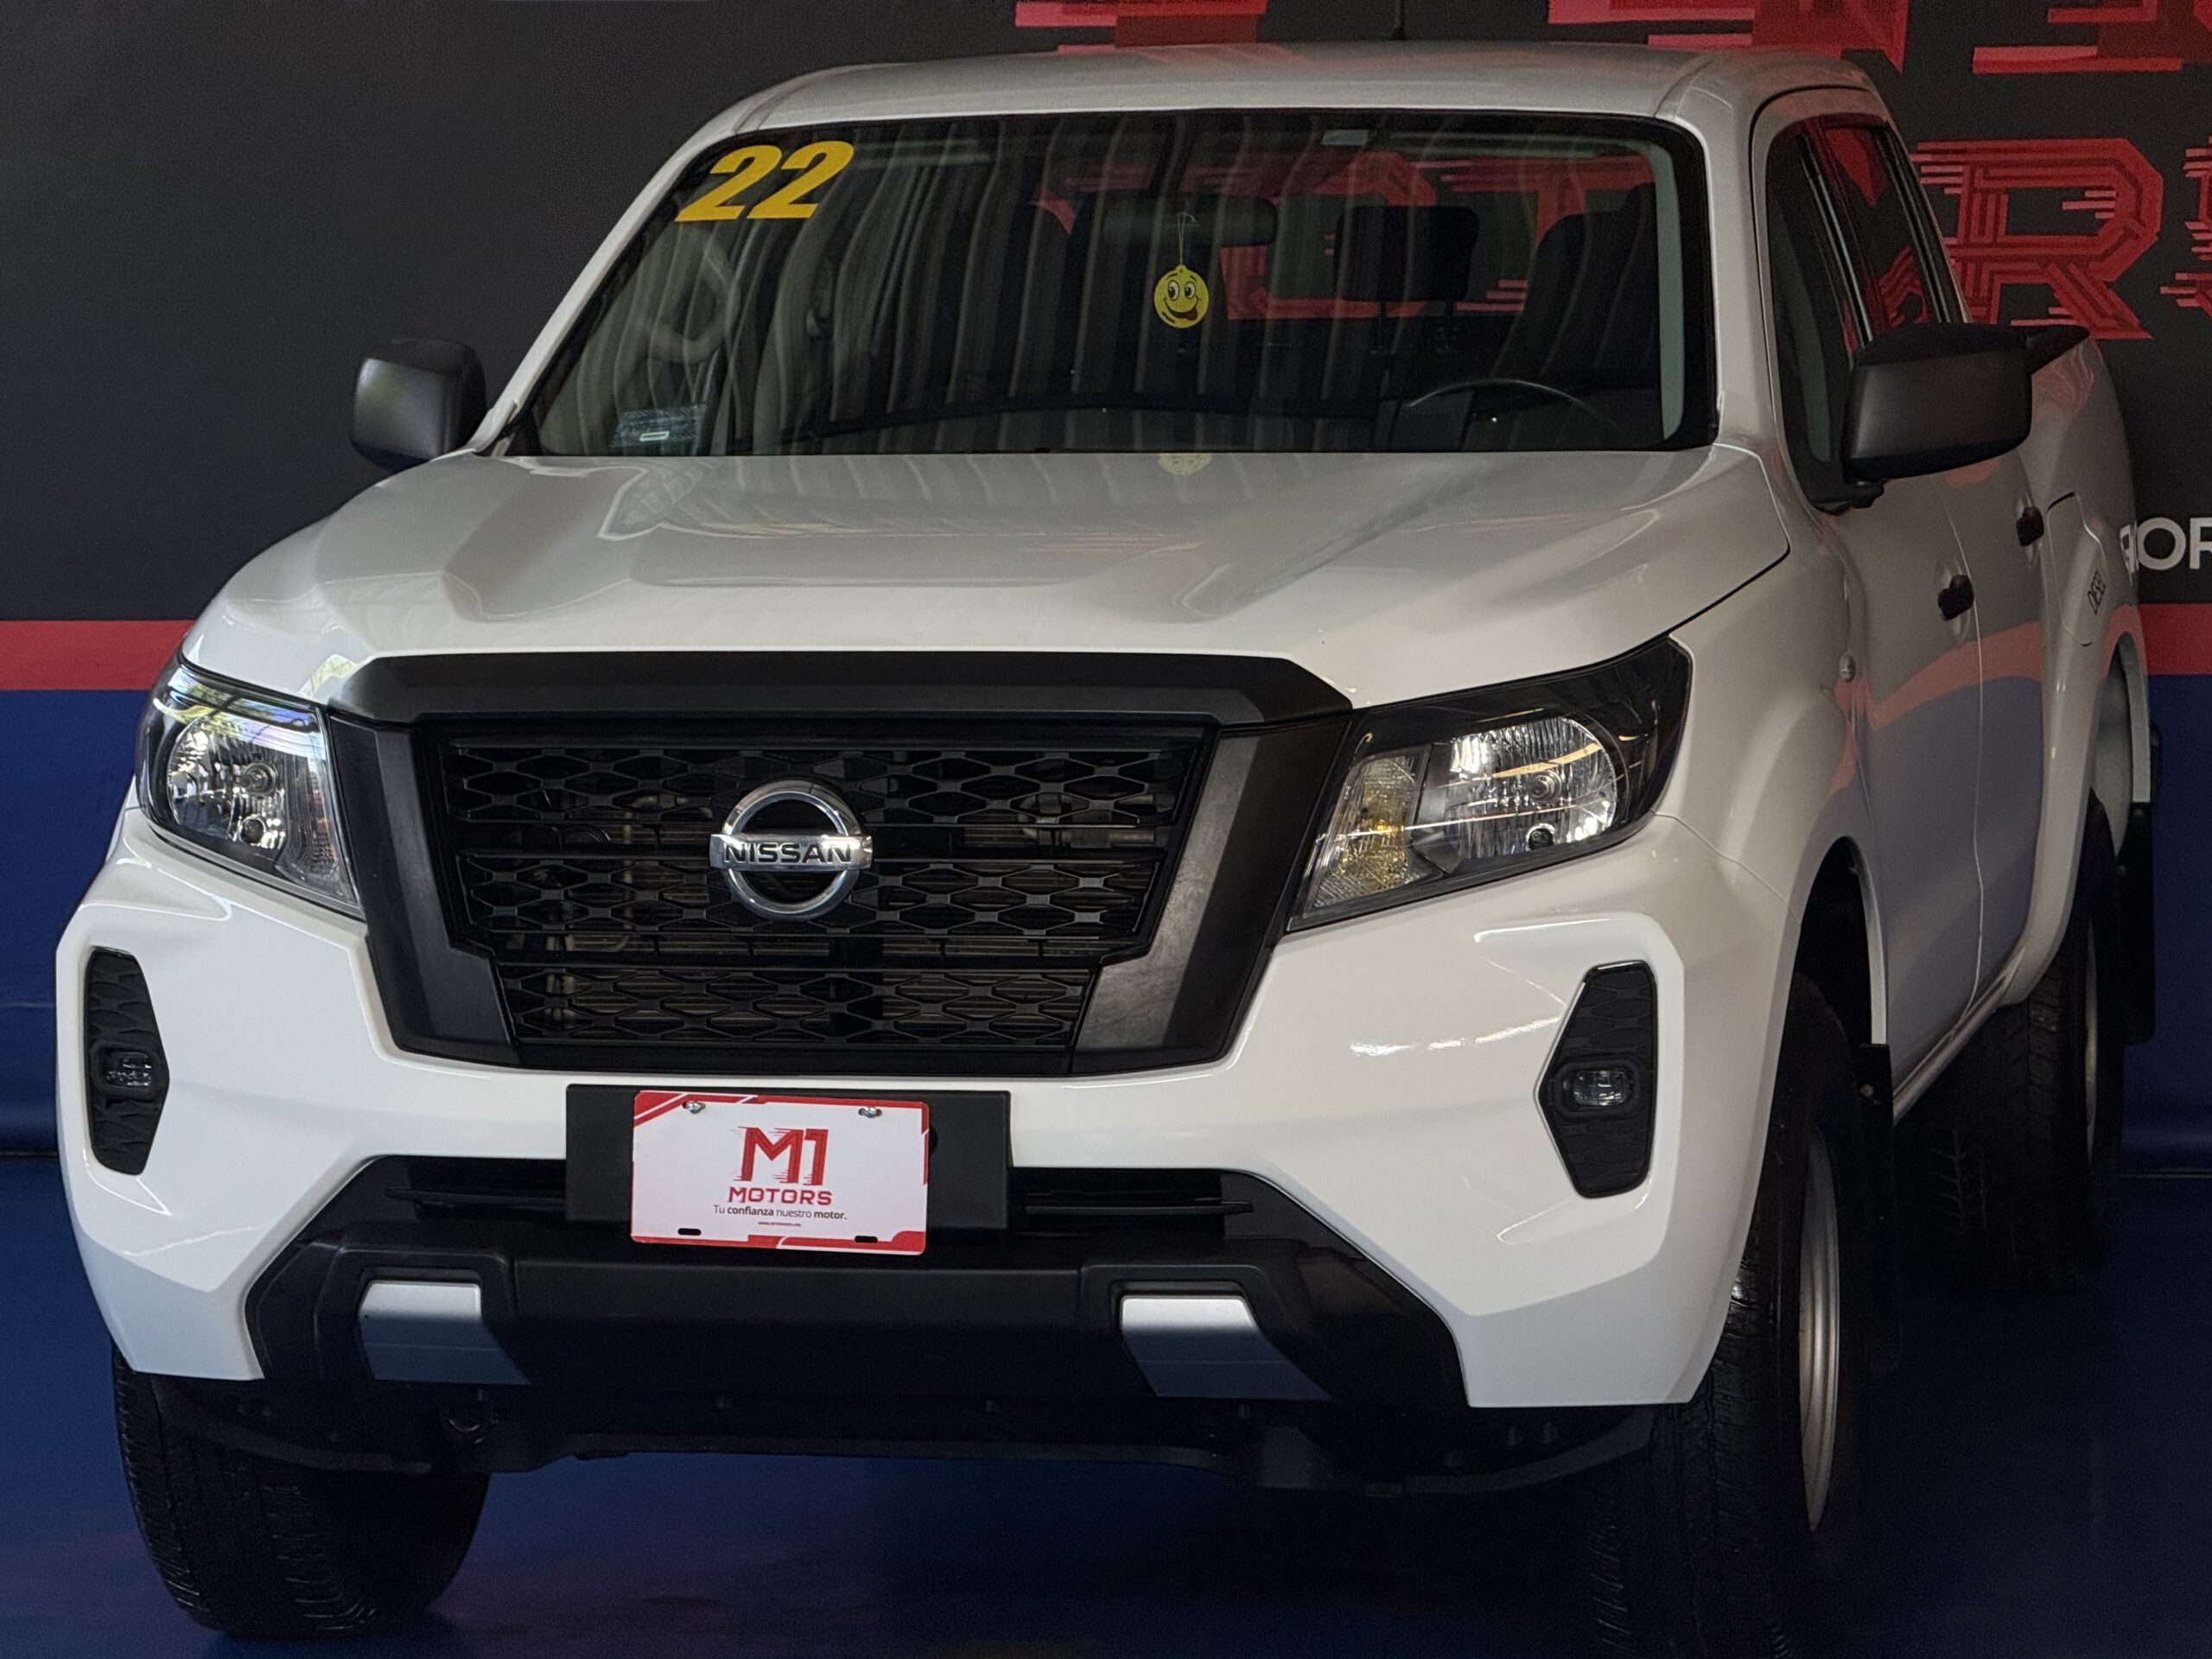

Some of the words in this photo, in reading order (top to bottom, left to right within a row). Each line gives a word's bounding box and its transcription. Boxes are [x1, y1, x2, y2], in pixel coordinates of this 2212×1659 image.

[674, 140, 855, 223] 22
[724, 842, 852, 864] NISSAN
[730, 1126, 830, 1186] M1
[728, 1186, 833, 1206] MOTORS
[713, 1205, 726, 1215] Tu
[727, 1206, 774, 1217] confianza
[776, 1209, 812, 1218] nuestro
[813, 1211, 848, 1220] motor.
